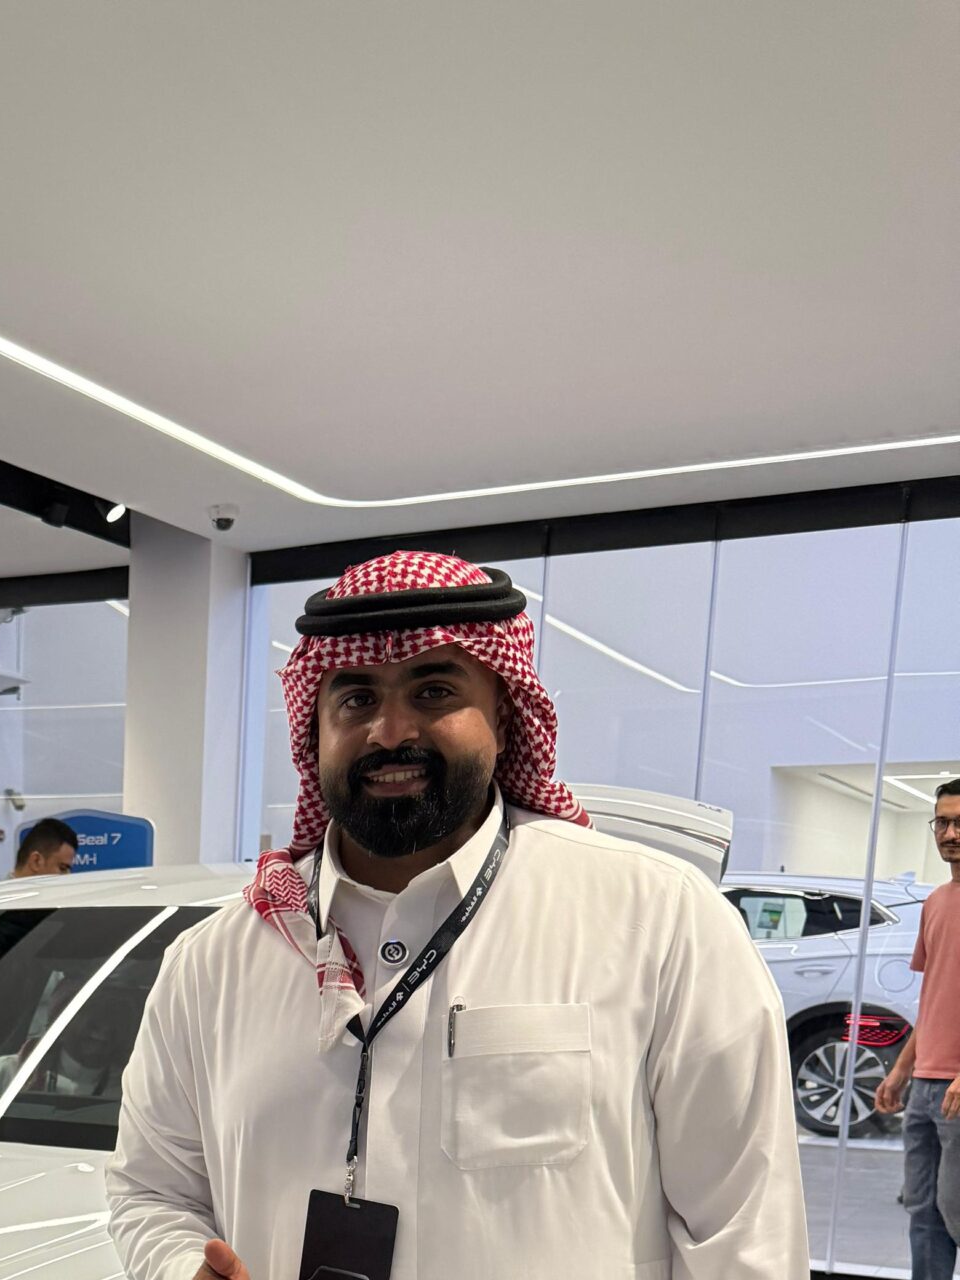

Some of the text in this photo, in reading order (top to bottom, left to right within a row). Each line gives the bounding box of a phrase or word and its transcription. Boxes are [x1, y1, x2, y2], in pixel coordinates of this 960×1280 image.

[76, 833, 122, 846] Seal 7
[72, 852, 97, 866] M-i
[483, 848, 501, 881] BYD
[407, 949, 437, 985] BYD
